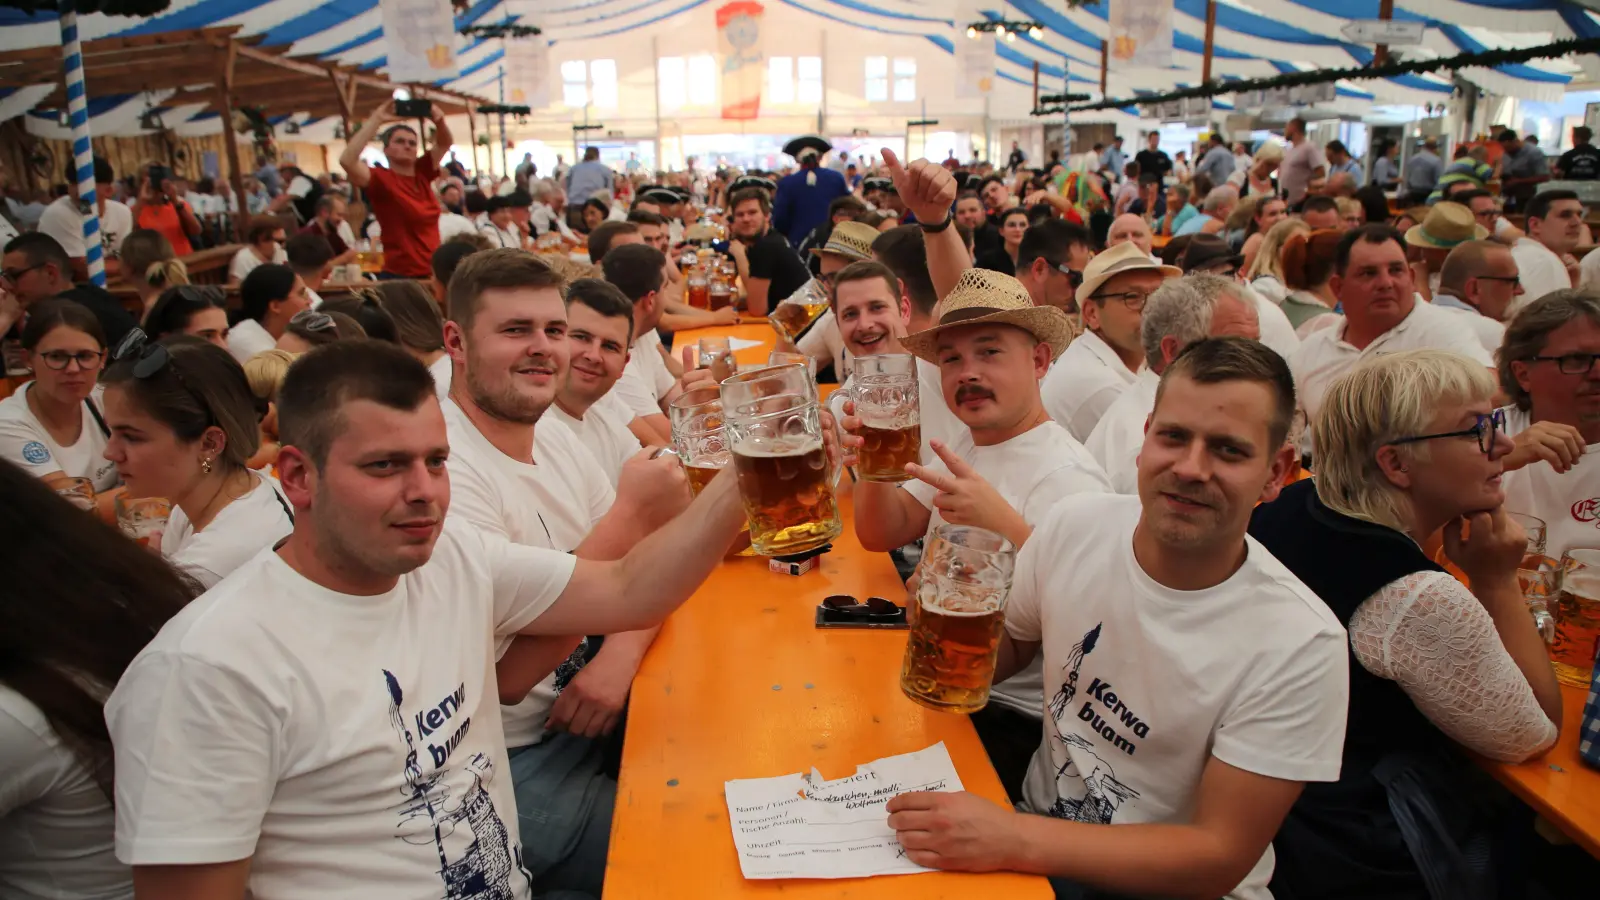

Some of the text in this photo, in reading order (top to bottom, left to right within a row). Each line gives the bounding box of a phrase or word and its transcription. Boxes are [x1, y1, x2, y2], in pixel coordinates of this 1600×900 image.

[415, 682, 466, 741] Kerwa
[1077, 702, 1136, 755] buam
[1086, 678, 1150, 739] Kerwa
[428, 717, 471, 769] buam
[736, 804, 764, 813] Name
[738, 813, 782, 824] Personen
[740, 824, 770, 833] Tische
